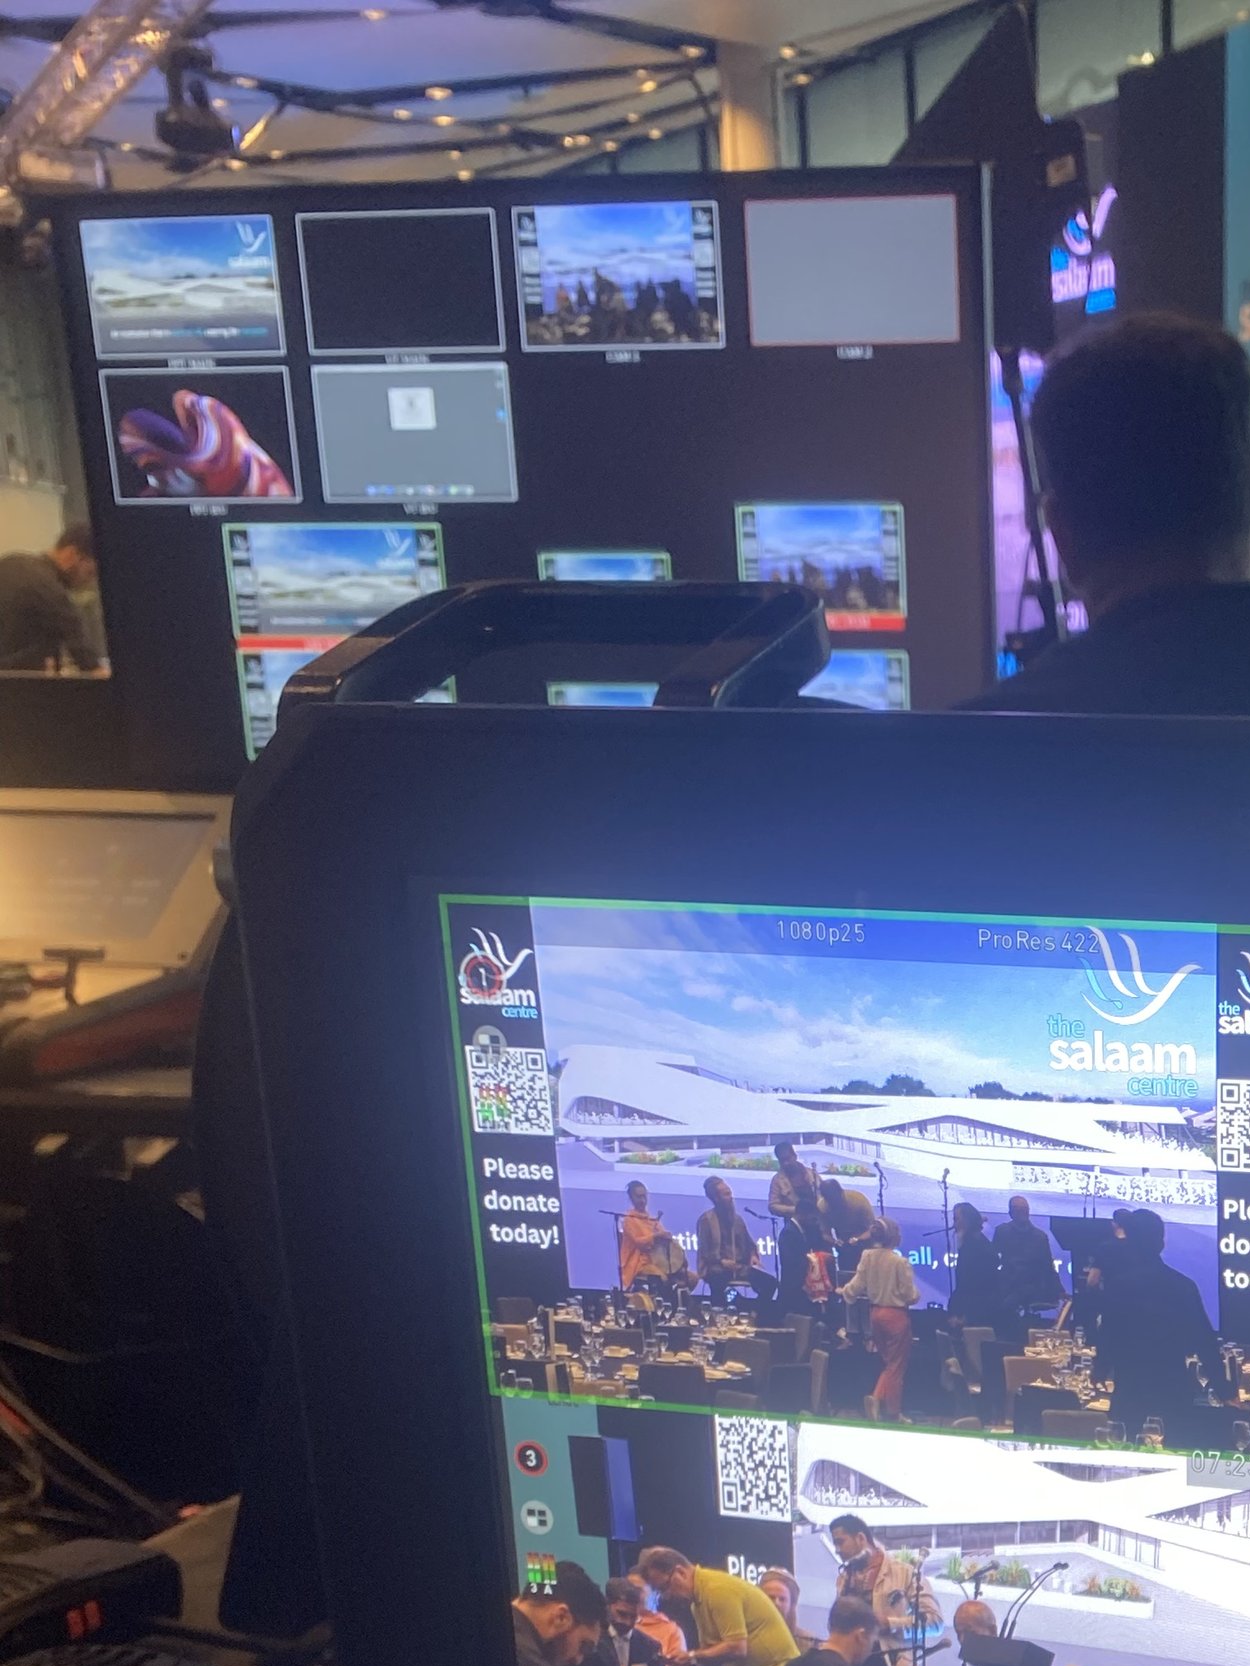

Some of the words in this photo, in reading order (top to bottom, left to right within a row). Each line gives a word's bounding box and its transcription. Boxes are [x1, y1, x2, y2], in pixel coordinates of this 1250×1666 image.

[777, 920, 865, 945] 1080p25
[978, 928, 1055, 951] ProRes
[1061, 931, 1099, 953] 422
[502, 1005, 539, 1019] centre
[1218, 1001, 1240, 1017] the
[1047, 1013, 1085, 1039] the
[1048, 1031, 1197, 1076] salaam
[1127, 1073, 1199, 1099] centre
[482, 1157, 554, 1182] Please
[483, 1189, 561, 1215] donate
[489, 1221, 561, 1250] today!
[524, 1449, 537, 1467] 3
[530, 1583, 538, 1594] 3
[543, 1585, 553, 1595] A
